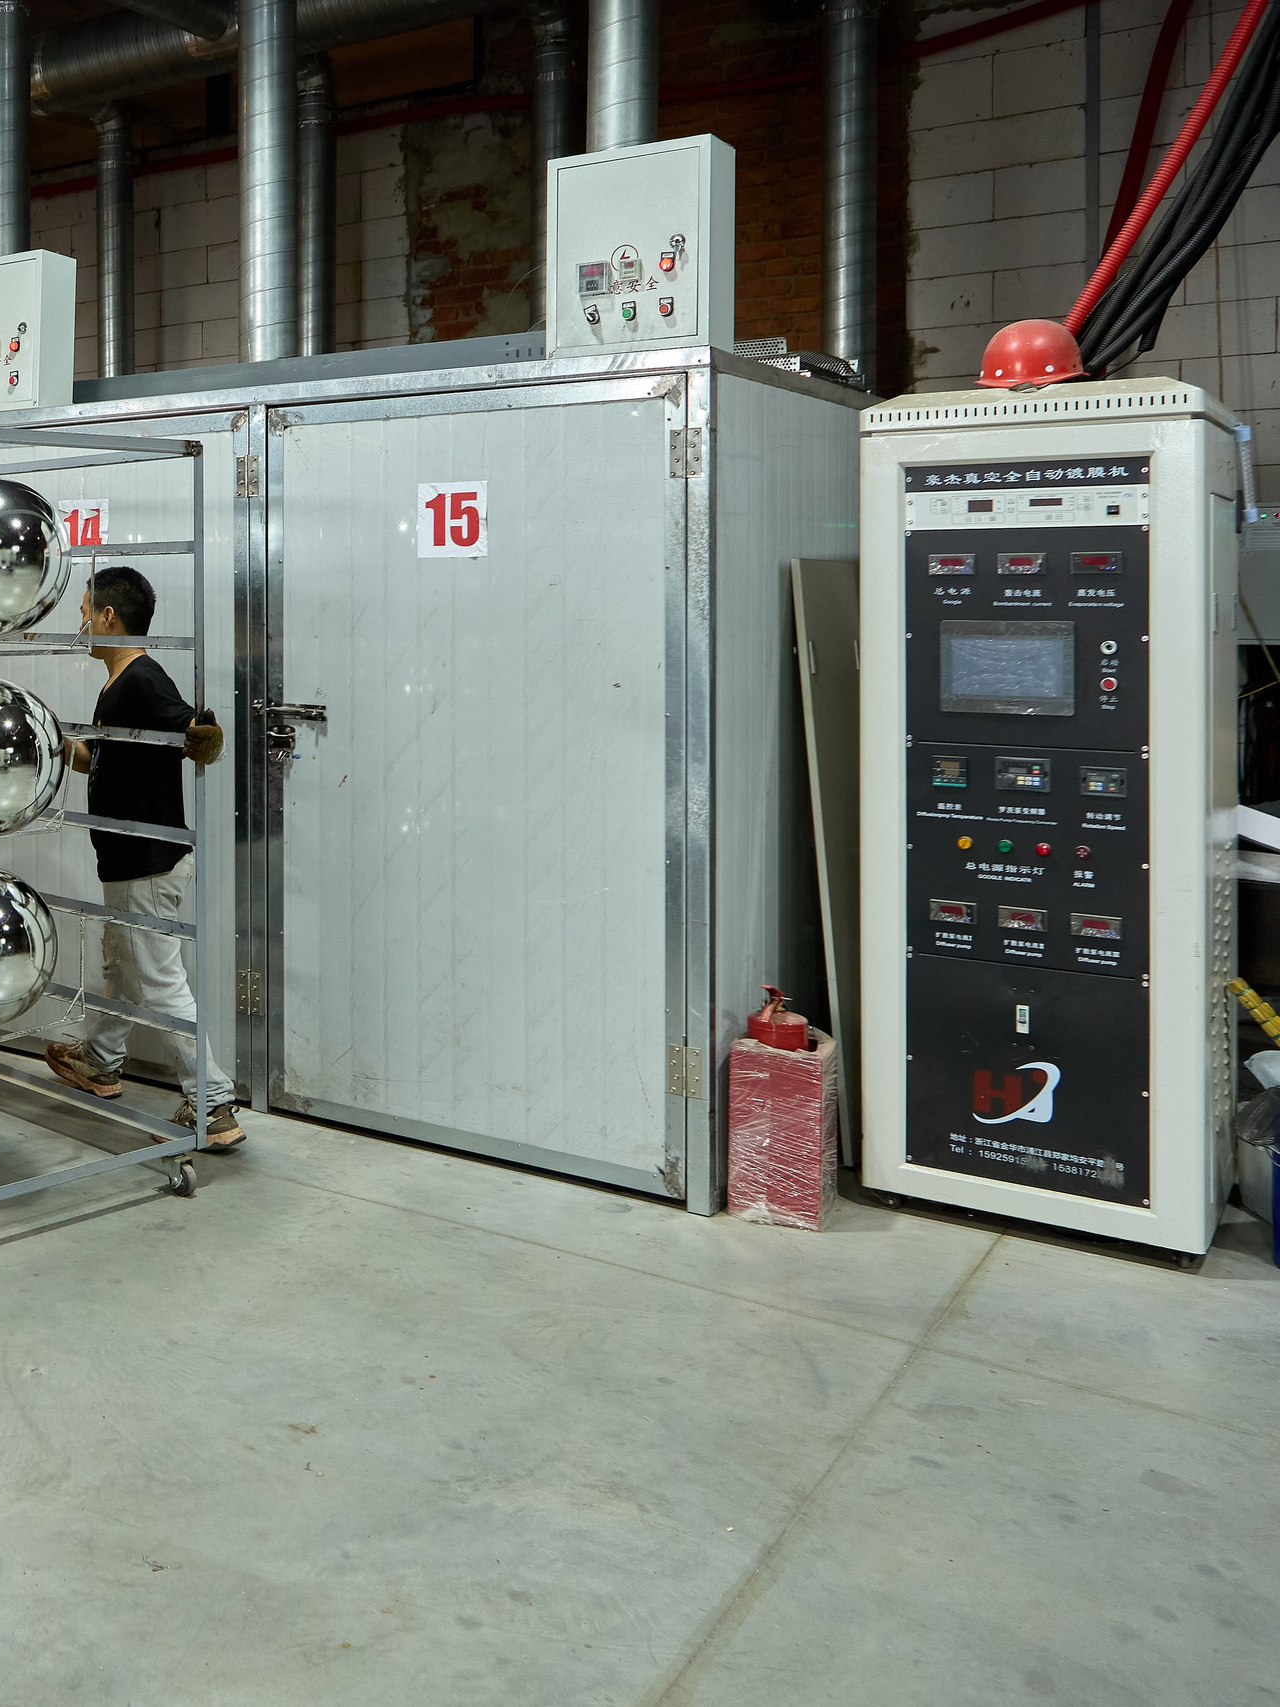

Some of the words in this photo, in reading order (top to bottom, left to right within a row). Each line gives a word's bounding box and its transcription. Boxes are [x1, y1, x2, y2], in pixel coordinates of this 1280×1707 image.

[593, 276, 659, 295] 意安全
[924, 465, 1129, 486] 豪杰真空全自动镀膜机
[63, 508, 103, 546] 14
[425, 492, 480, 547] 15
[964, 861, 1046, 876] 总电源指示灯
[977, 873, 1003, 881] GOOGLE
